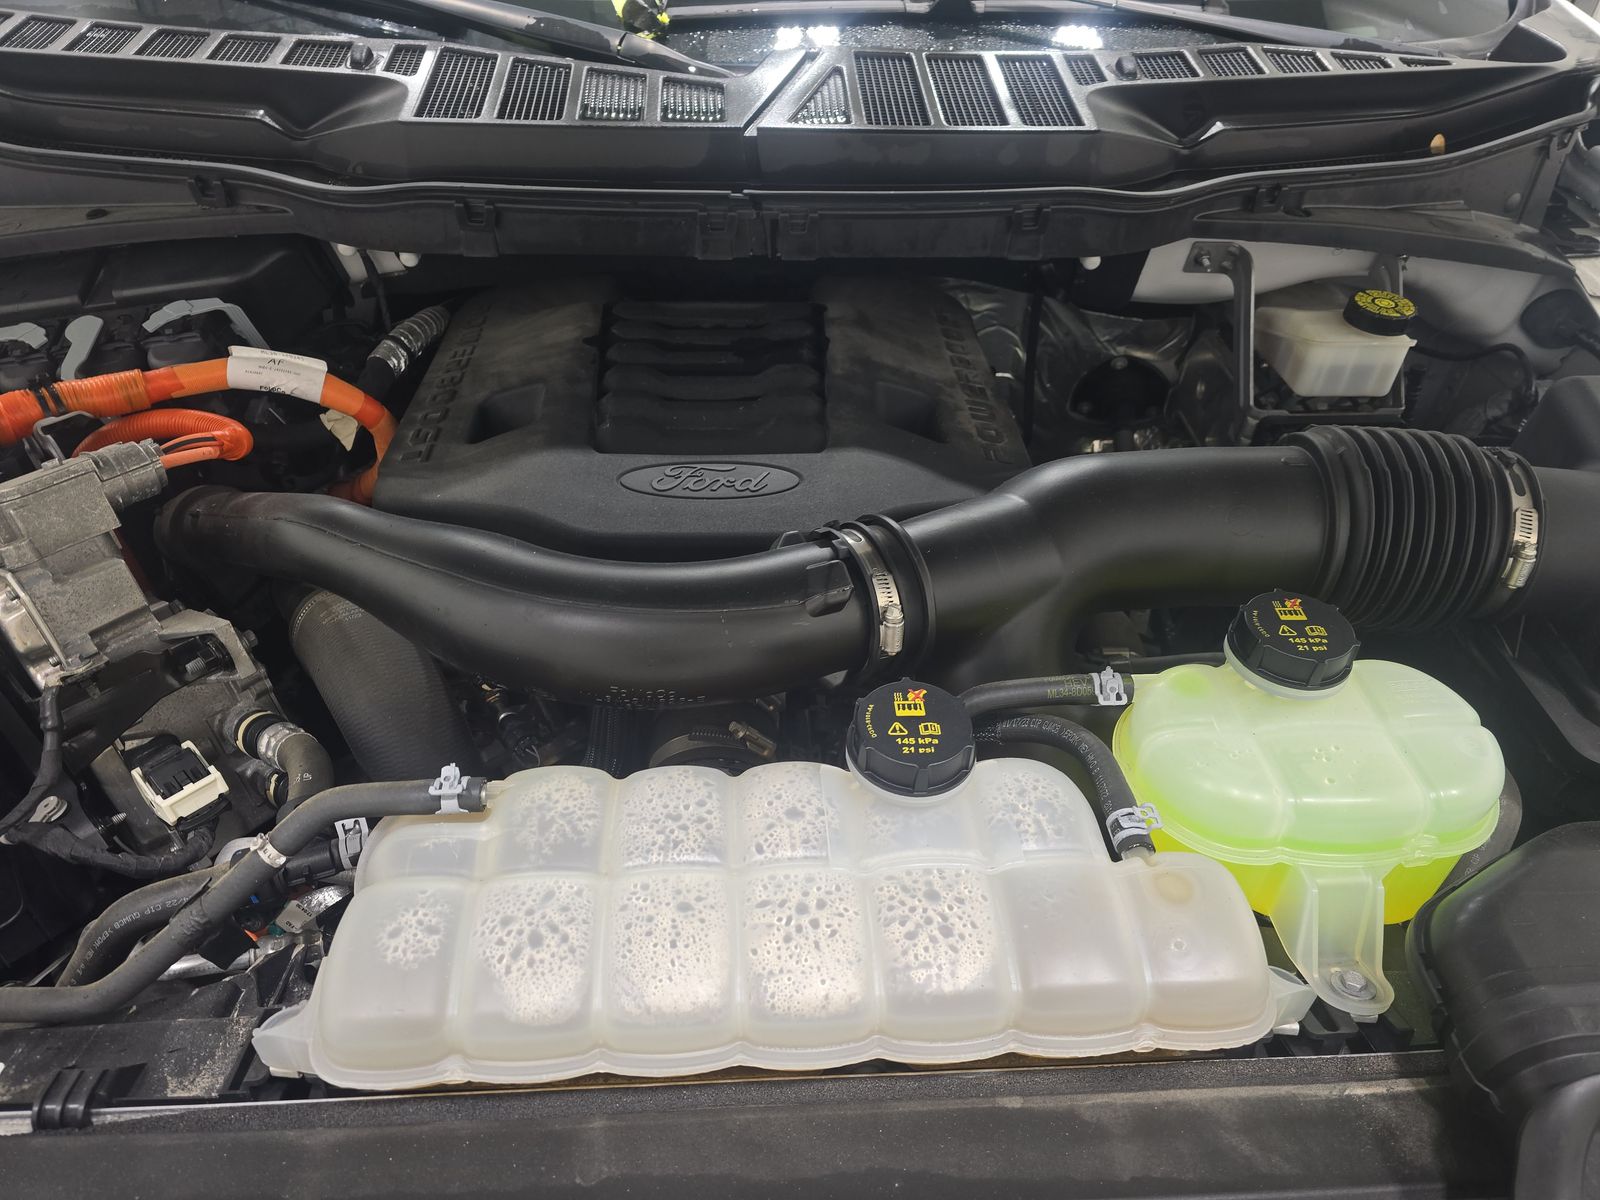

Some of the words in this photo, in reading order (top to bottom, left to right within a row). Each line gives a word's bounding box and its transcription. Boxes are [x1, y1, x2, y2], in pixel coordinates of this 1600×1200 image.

[651, 465, 771, 493] Ford
[1064, 679, 1088, 688] HEV
[895, 737, 916, 745] 145
[918, 737, 939, 745] kPa
[902, 746, 915, 754] 21
[918, 746, 935, 754] psi
[144, 904, 162, 915] CIP
